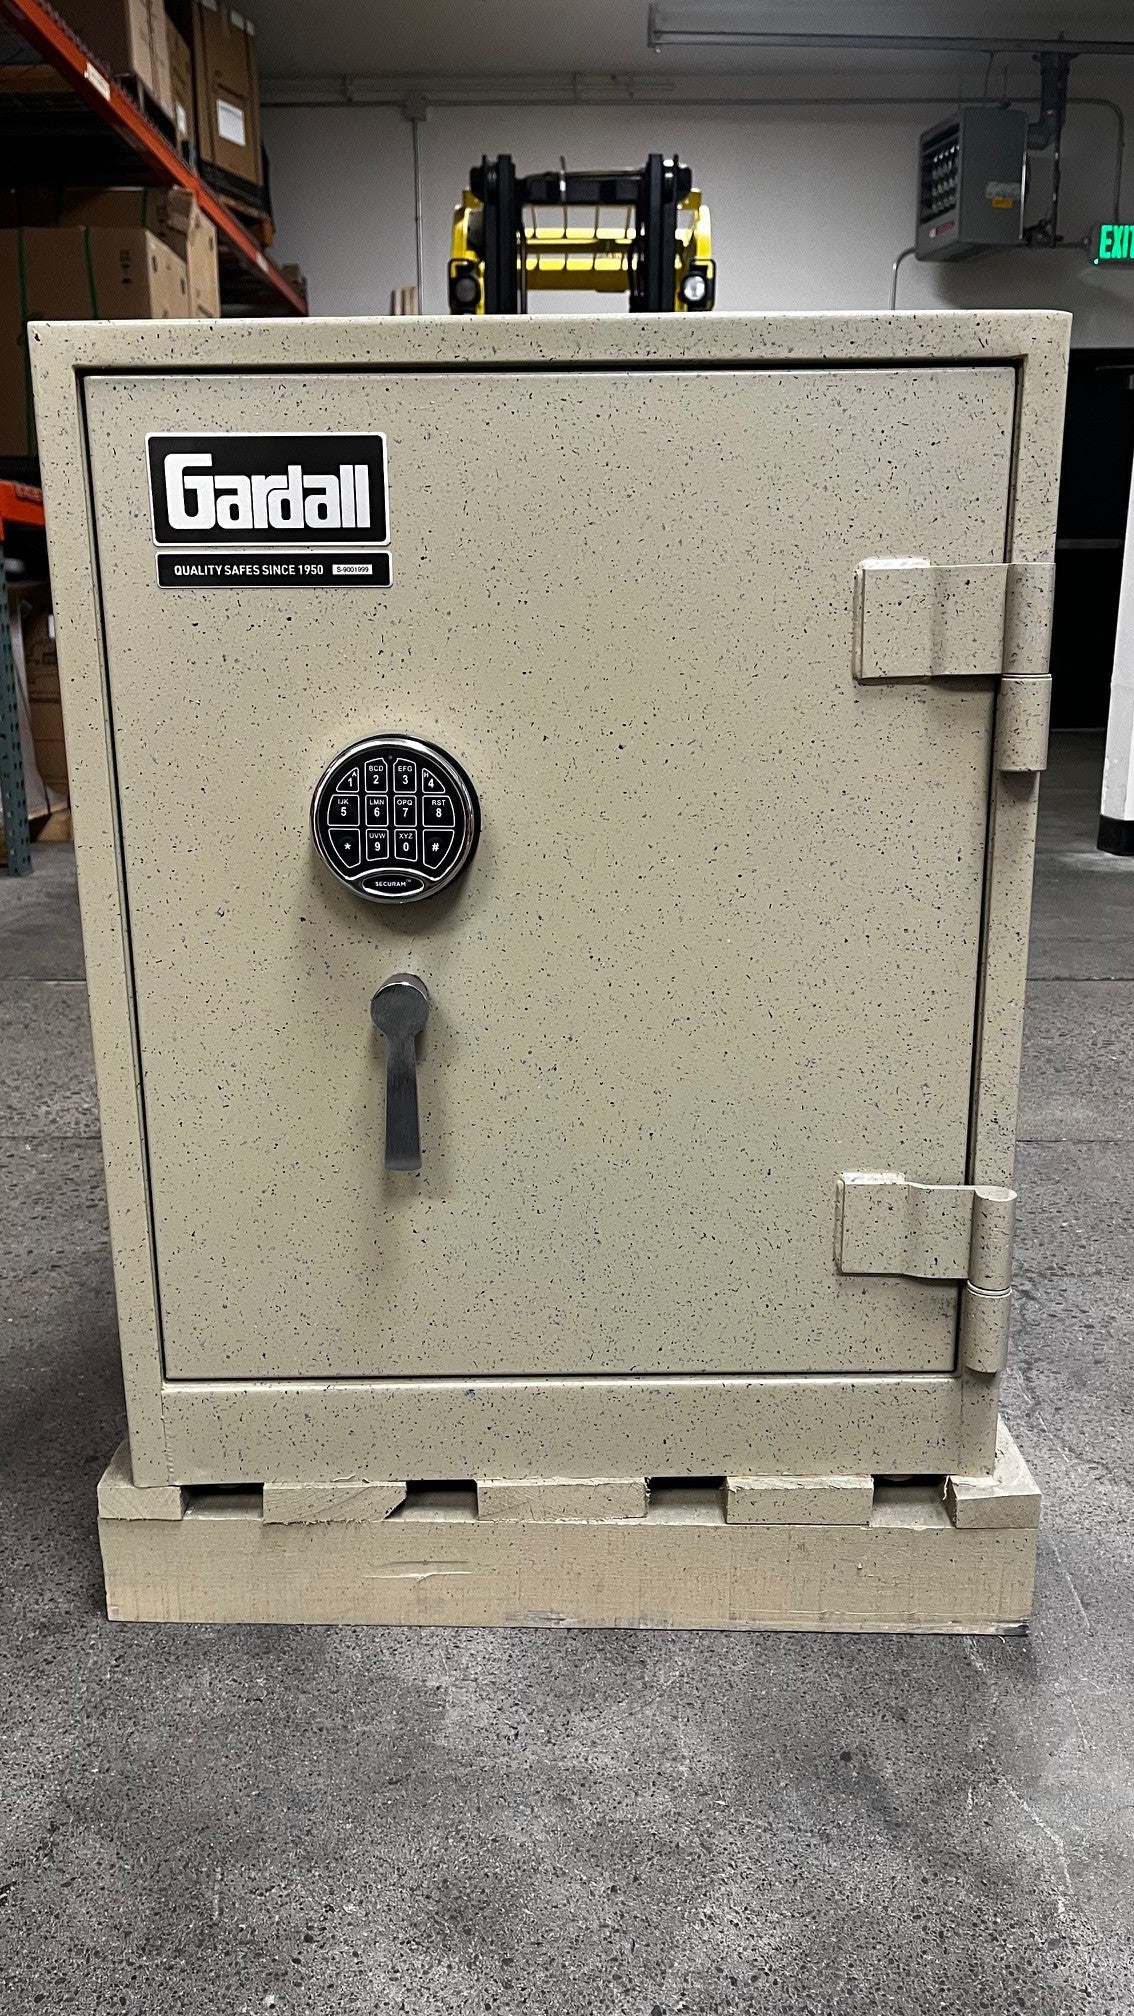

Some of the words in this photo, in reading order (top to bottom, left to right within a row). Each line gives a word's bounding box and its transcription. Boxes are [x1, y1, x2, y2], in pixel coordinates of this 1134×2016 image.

[164, 453, 371, 530] Gardall
[174, 565, 222, 576] QUALITY
[224, 565, 260, 576] SAFES
[262, 564, 296, 575] SINCE
[298, 564, 324, 575] 1950
[348, 777, 353, 787] 1
[373, 774, 380, 785] 2
[402, 774, 409, 785] 3
[428, 778, 435, 788] 4
[340, 806, 347, 817] 5
[374, 807, 380, 817] 6
[402, 807, 409, 818] 7
[435, 808, 442, 818] 8
[374, 842, 381, 852] 9
[403, 842, 409, 852] 0
[432, 843, 440, 852] #
